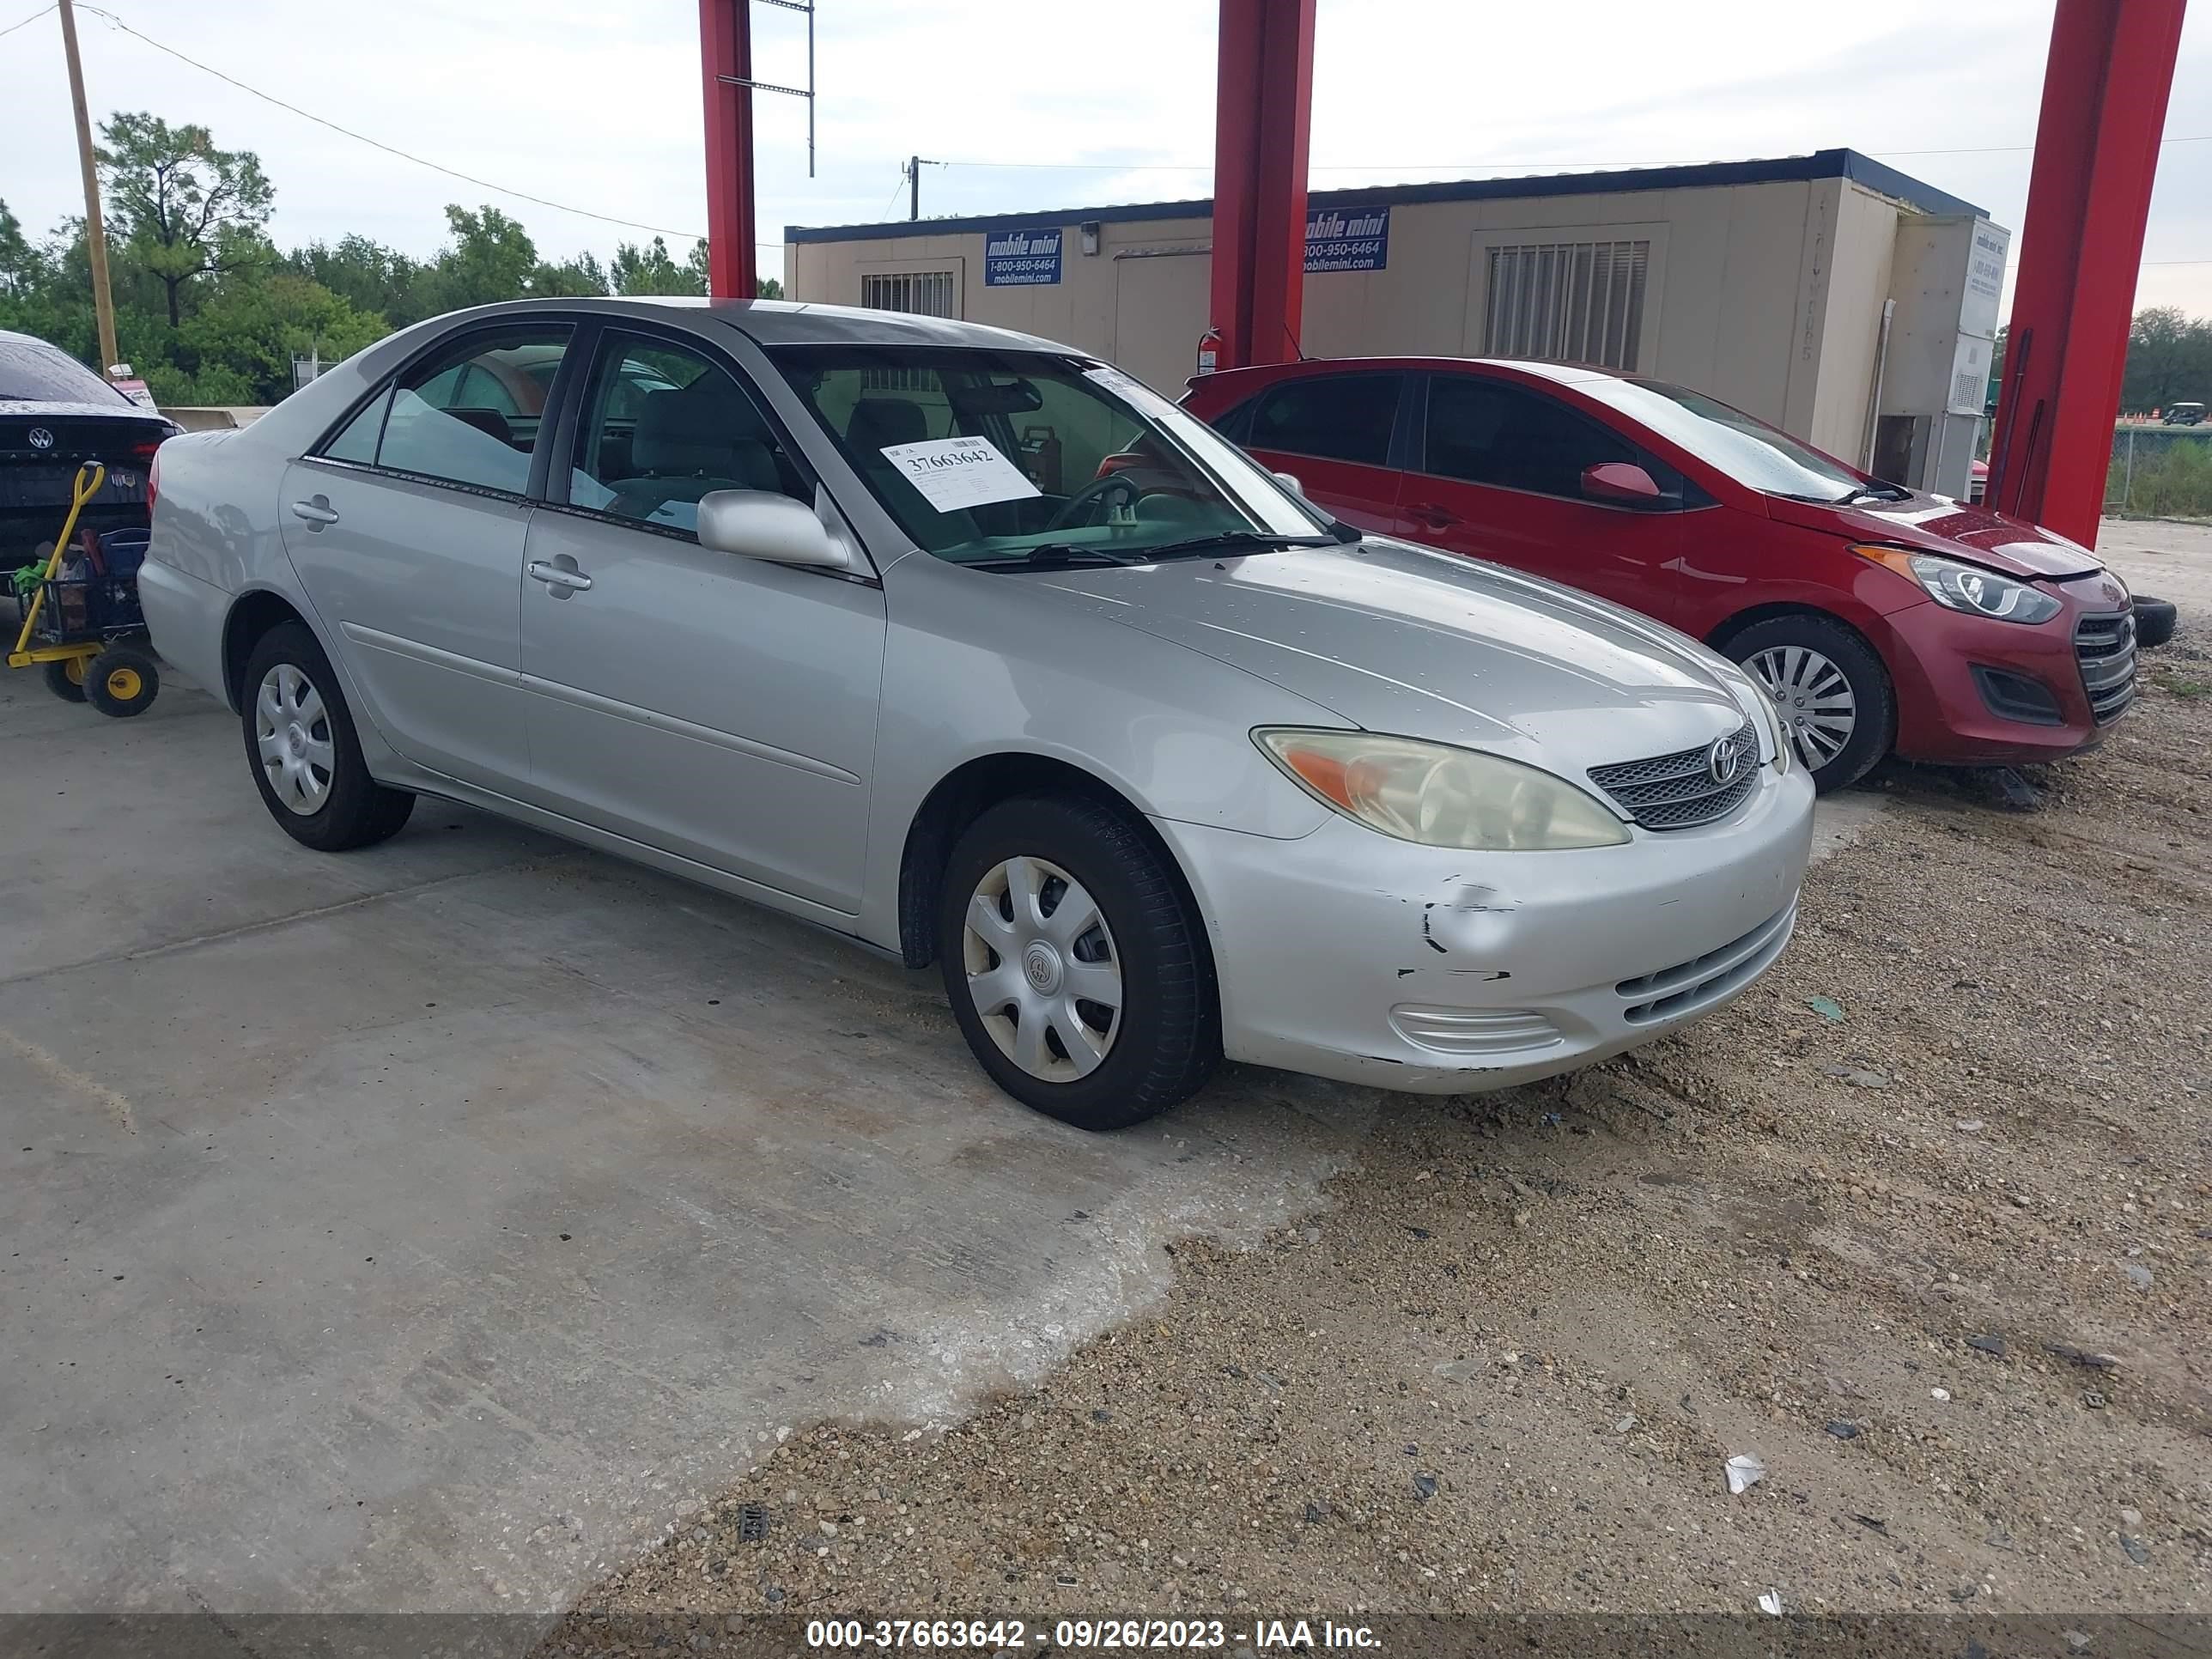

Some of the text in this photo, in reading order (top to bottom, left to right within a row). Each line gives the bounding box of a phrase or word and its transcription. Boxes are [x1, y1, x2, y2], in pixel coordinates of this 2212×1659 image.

[1305, 212, 1385, 239] obile mini
[988, 233, 1060, 256] mobile mini
[1304, 241, 1380, 258] 00-950-6464
[990, 259, 1055, 272] 1-800-950-6464
[994, 272, 1052, 284] mobilemini.com
[907, 450, 994, 472] 37663642
